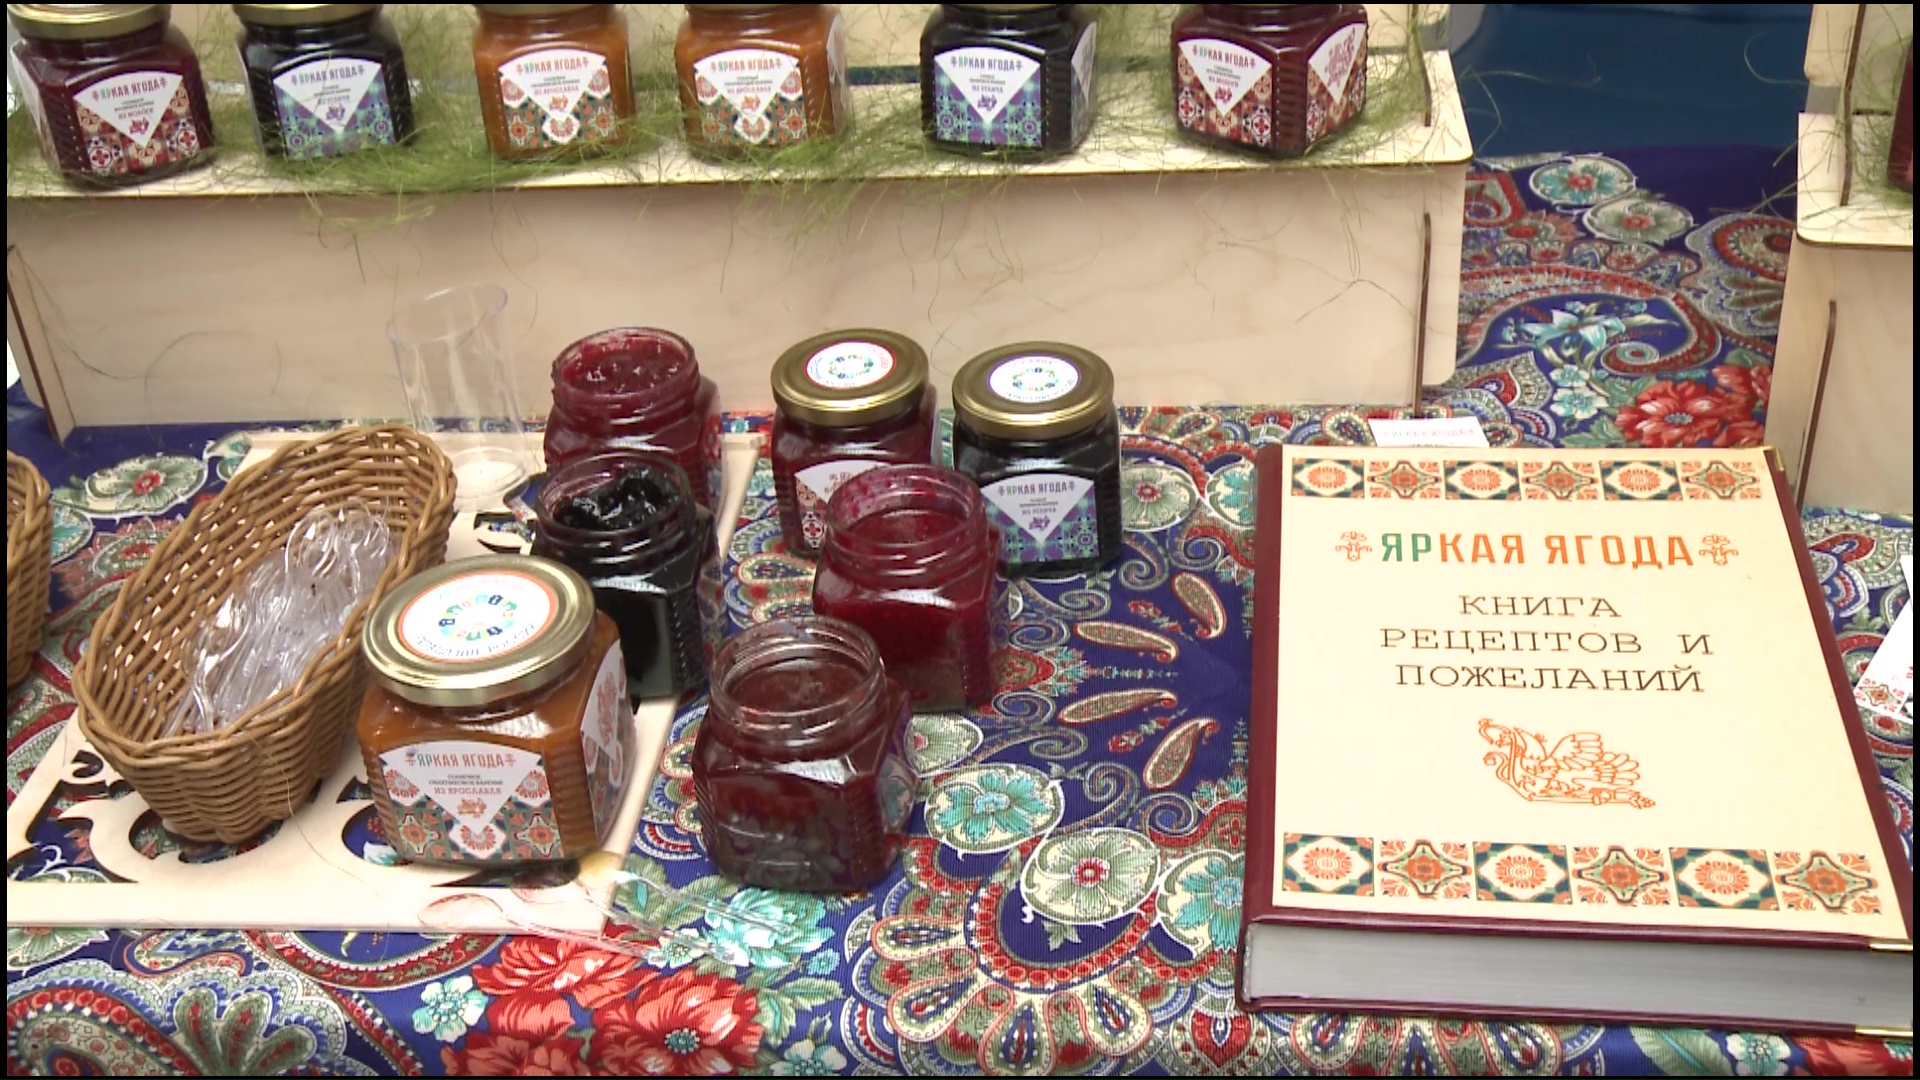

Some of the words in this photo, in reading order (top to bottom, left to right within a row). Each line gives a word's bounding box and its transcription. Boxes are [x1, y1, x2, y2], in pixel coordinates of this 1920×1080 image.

[524, 61, 551, 74] ЯРКАЯ
[554, 57, 582, 72] ЯГОДА
[717, 60, 745, 72] ЯРКАЯ
[747, 58, 775, 70] ЯГОДА
[958, 56, 985, 69] ЯРКАЯ
[988, 59, 1015, 71] ЯГОДА
[1199, 46, 1223, 62] ЯРКАЯ
[1224, 52, 1249, 68] ЯГОДА
[299, 70, 327, 84] ЯРКАЯ
[329, 66, 357, 80] ЯГОДА
[100, 84, 129, 99] ЯРКАЯ
[131, 78, 160, 94] ЯГОДА
[1006, 485, 1036, 496] ЯРКАЯ
[1039, 481, 1067, 494] ЯГОДА
[1382, 533, 1525, 564] ЯРКАЯ
[1545, 535, 1693, 569] ЯГОДА
[1459, 595, 1622, 618] КНИГА
[1380, 628, 1642, 655] РЕЦЕПТОВ
[1678, 634, 1714, 656] И
[1396, 664, 1705, 693] ПОЖЕЛАНИЙ
[417, 753, 458, 767] ЯРКАЯ
[462, 753, 504, 768] ЯГОДА
